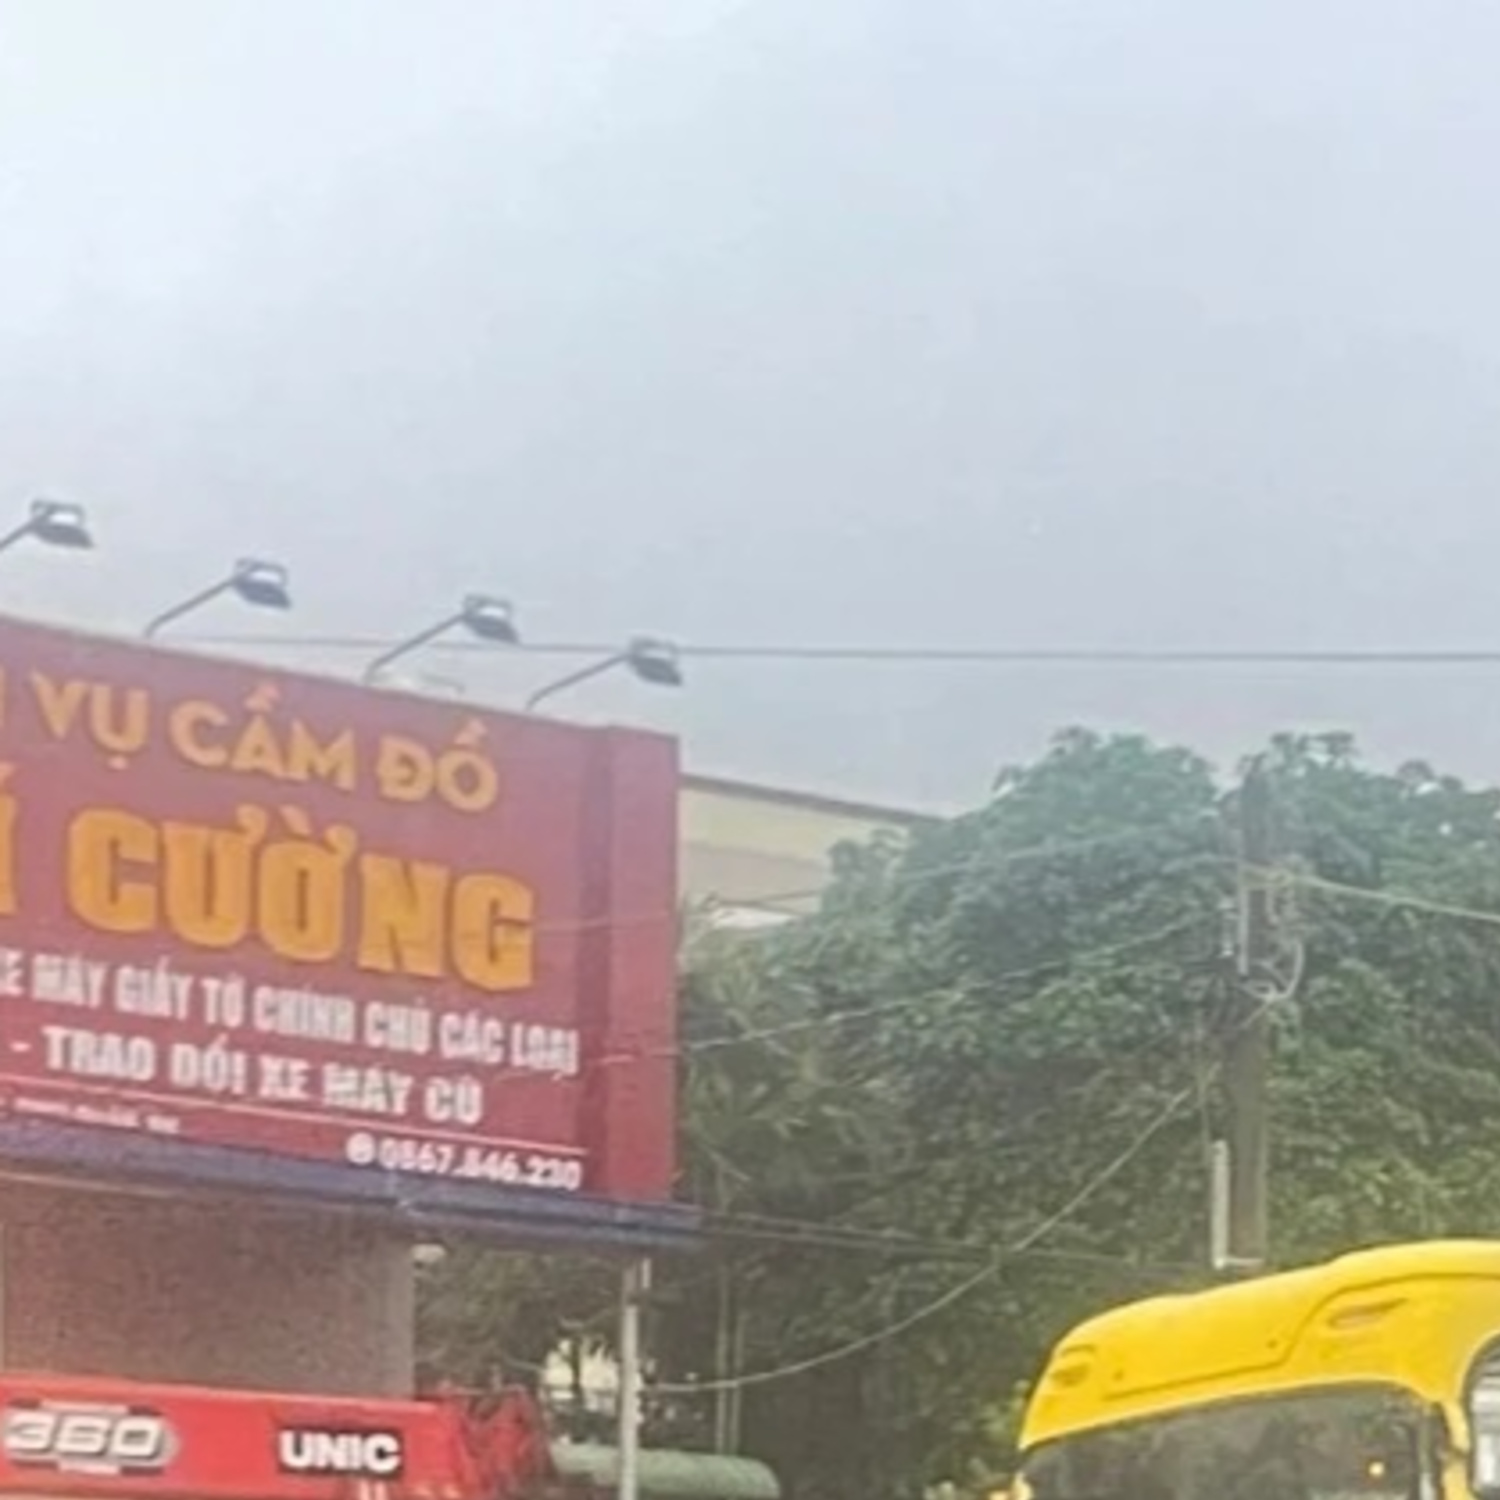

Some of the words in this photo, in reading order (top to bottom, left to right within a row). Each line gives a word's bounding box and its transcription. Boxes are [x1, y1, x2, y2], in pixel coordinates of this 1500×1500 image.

[30, 669, 149, 770] VỤ
[67, 803, 535, 992] CƯỜNG
[42, 1025, 156, 1082] TRAO
[257, 1053, 311, 1100] XE
[3, 1409, 163, 1459] 360
[279, 1430, 402, 1473] UNIC
